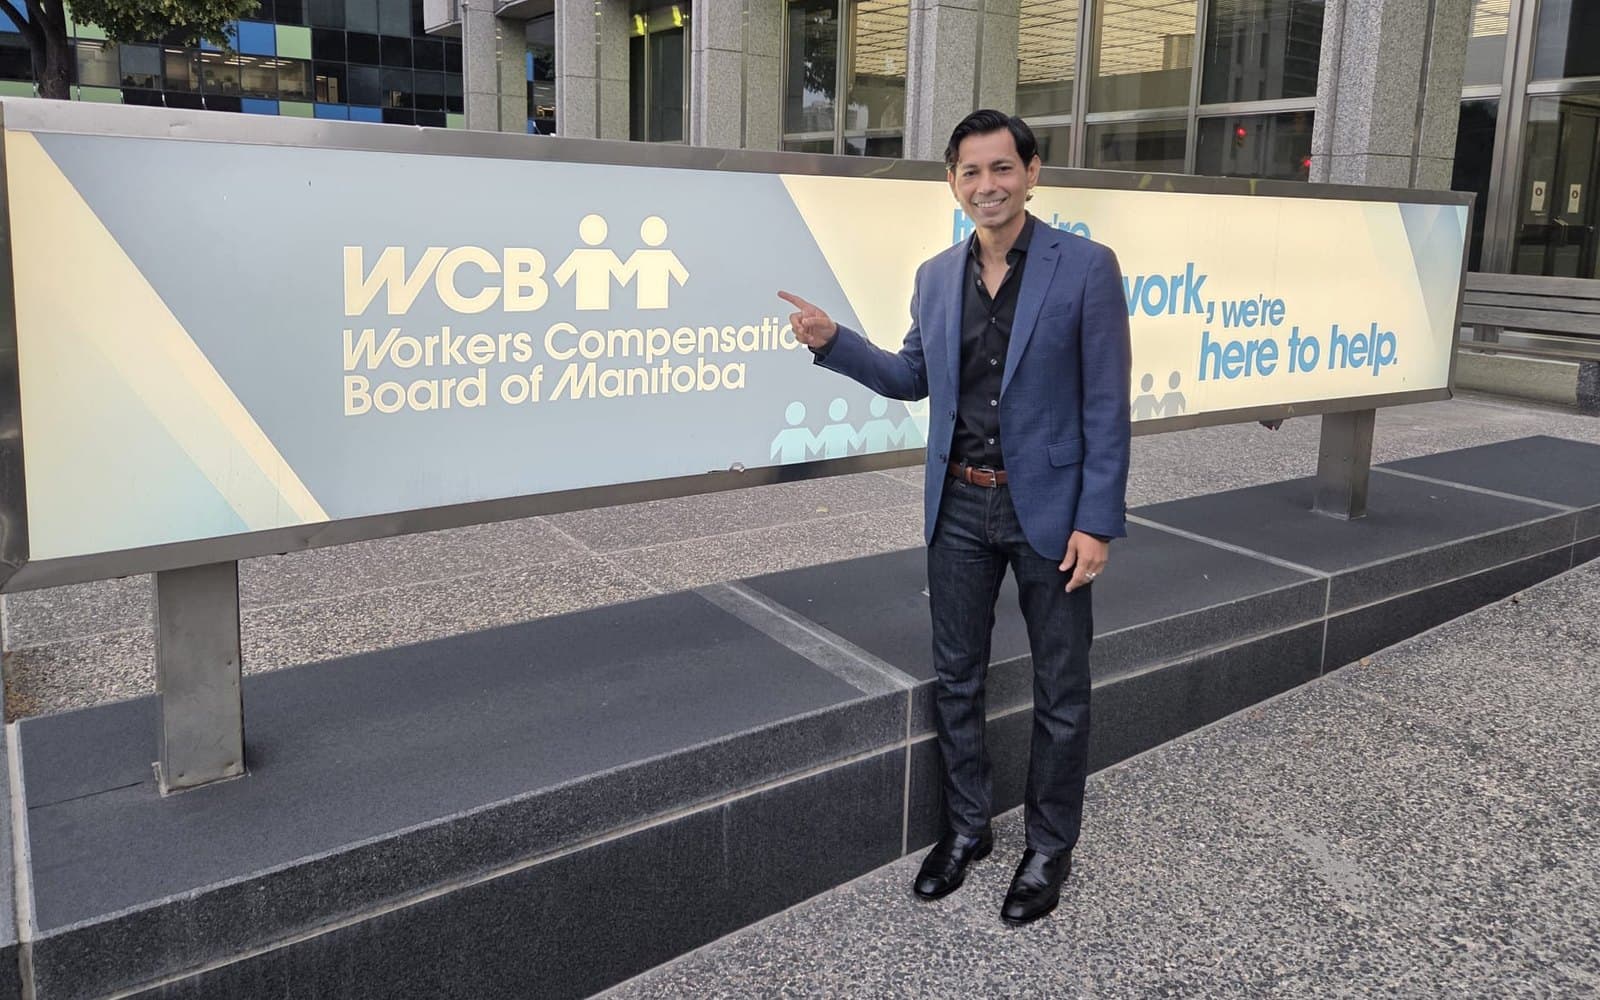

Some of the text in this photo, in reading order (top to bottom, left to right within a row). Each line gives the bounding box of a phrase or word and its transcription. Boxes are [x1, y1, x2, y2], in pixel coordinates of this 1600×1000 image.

[343, 245, 549, 316] WCB
[1222, 294, 1286, 328] we're
[343, 317, 807, 371] Workers Compensatio
[1199, 322, 1397, 381] here to help.
[343, 357, 746, 416] Board of Manitoba
